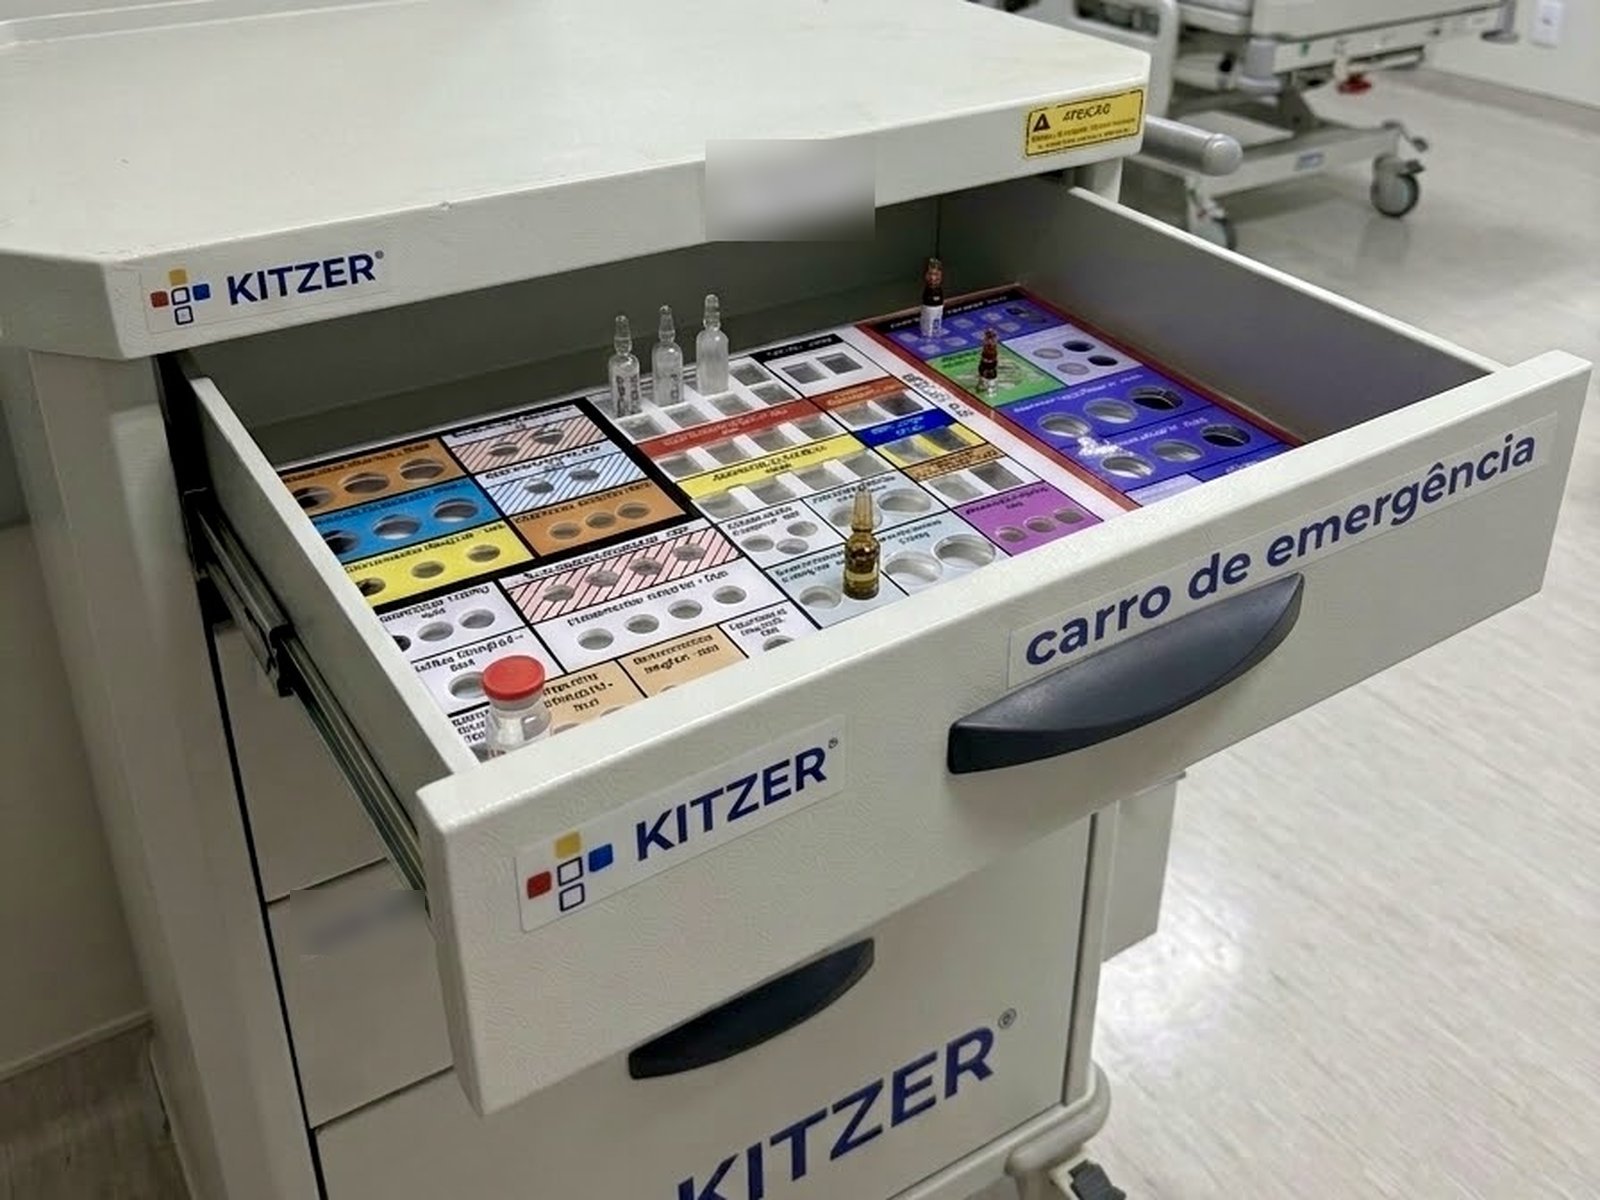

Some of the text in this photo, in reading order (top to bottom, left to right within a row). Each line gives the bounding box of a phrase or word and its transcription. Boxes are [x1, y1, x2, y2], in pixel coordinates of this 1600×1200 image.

[227, 252, 376, 307] KITZER
[1026, 433, 1536, 666] carro de emergência
[635, 746, 828, 862] KITZER
